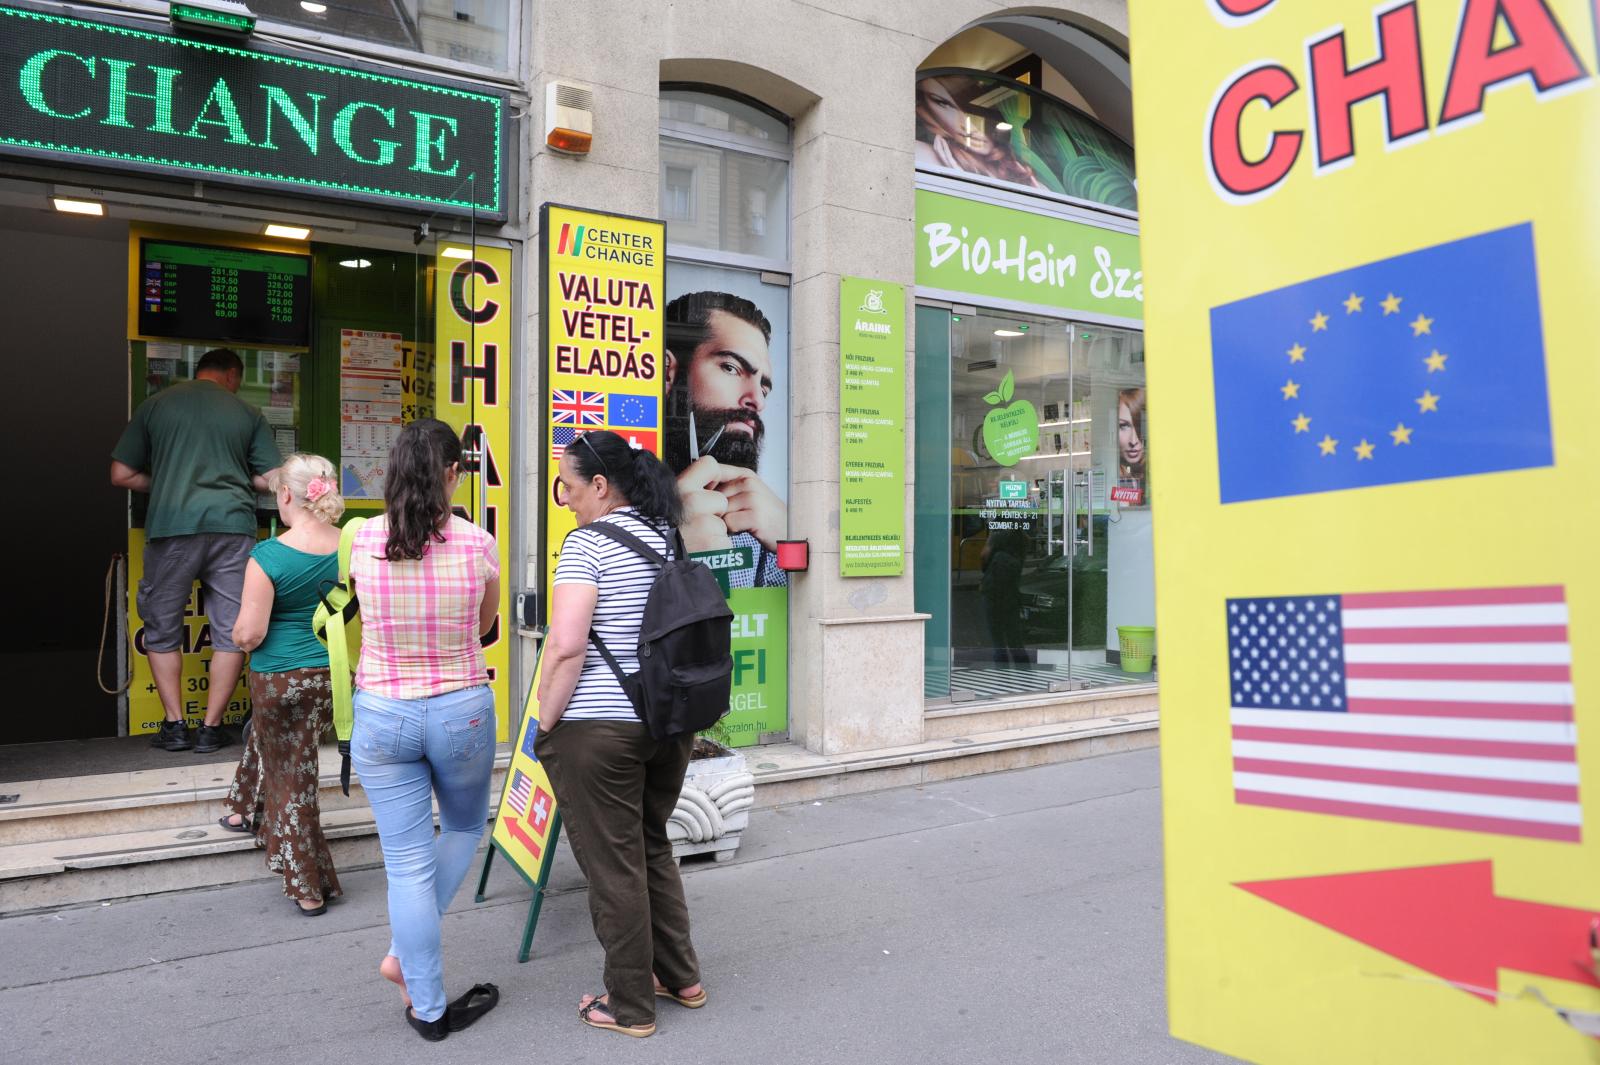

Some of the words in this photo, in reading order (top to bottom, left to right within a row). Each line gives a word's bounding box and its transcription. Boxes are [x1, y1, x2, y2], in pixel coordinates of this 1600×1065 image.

[19, 48, 459, 177] CHANGE
[585, 246, 654, 266] CHANGE
[587, 228, 652, 249] CENTER
[923, 221, 1077, 288] BioHair
[559, 272, 655, 310] VALUTA
[562, 305, 650, 343] VÉTEL-
[854, 318, 891, 334] ÁRAINK
[556, 345, 655, 380] ELADÁS
[986, 499, 1007, 508] NYITVA
